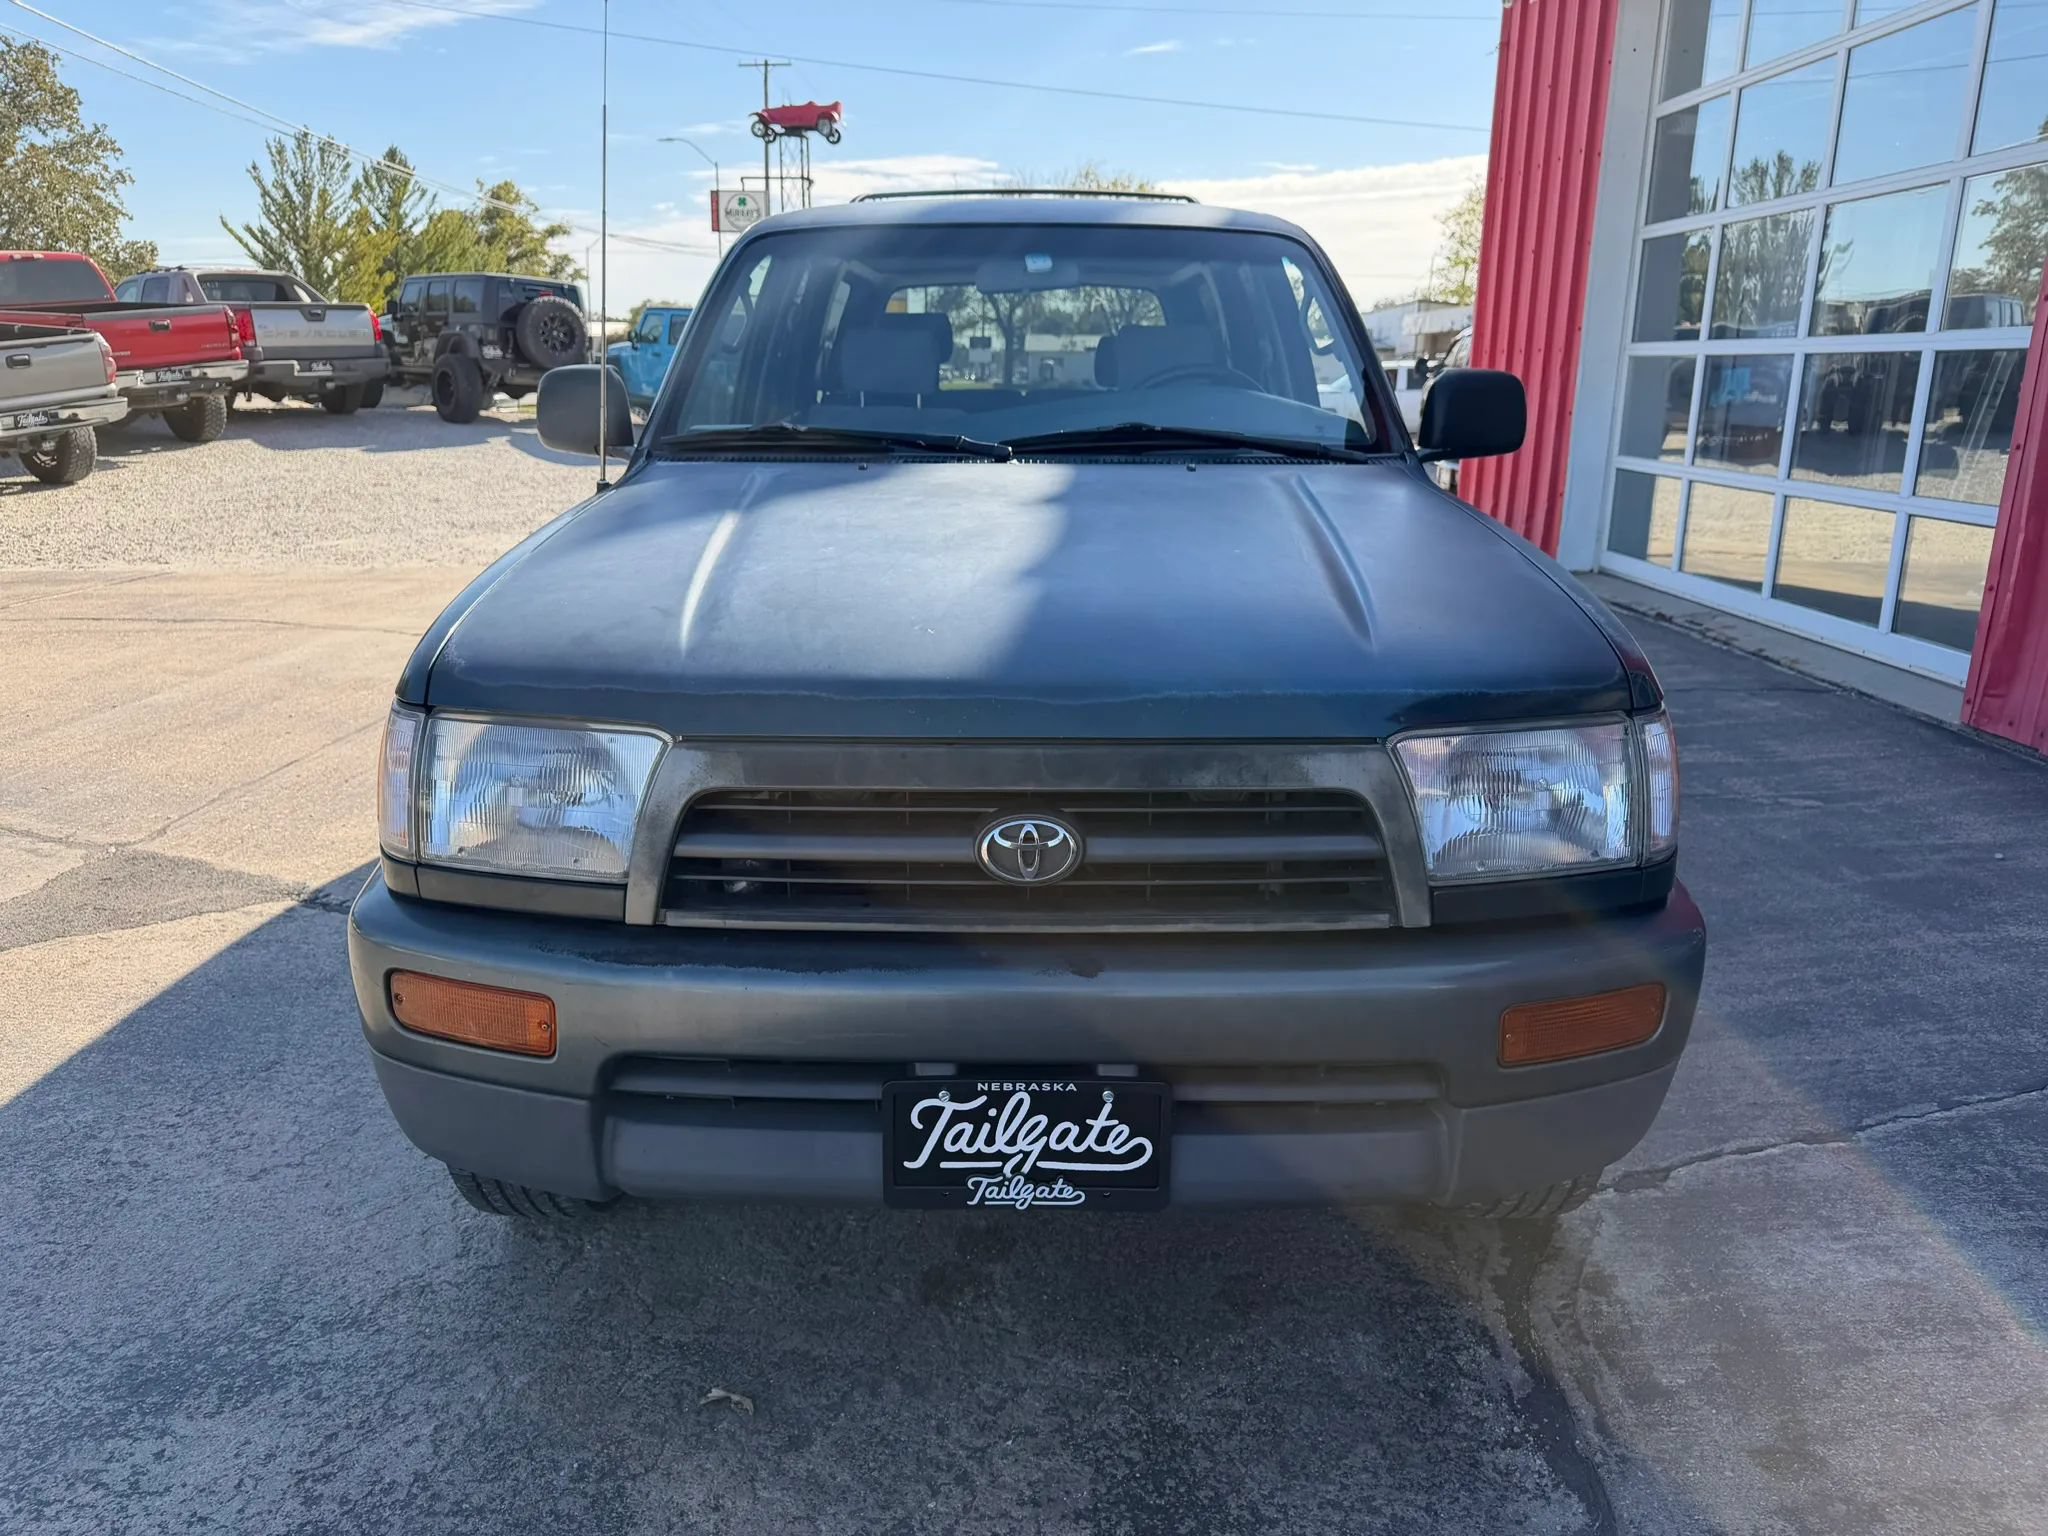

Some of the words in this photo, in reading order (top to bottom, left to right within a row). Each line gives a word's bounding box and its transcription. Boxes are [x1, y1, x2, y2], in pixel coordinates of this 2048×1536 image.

[977, 1082, 1078, 1092] NEBRASKA
[903, 1091, 1153, 1178] Tailgate
[967, 1175, 1086, 1210] Tailgate
